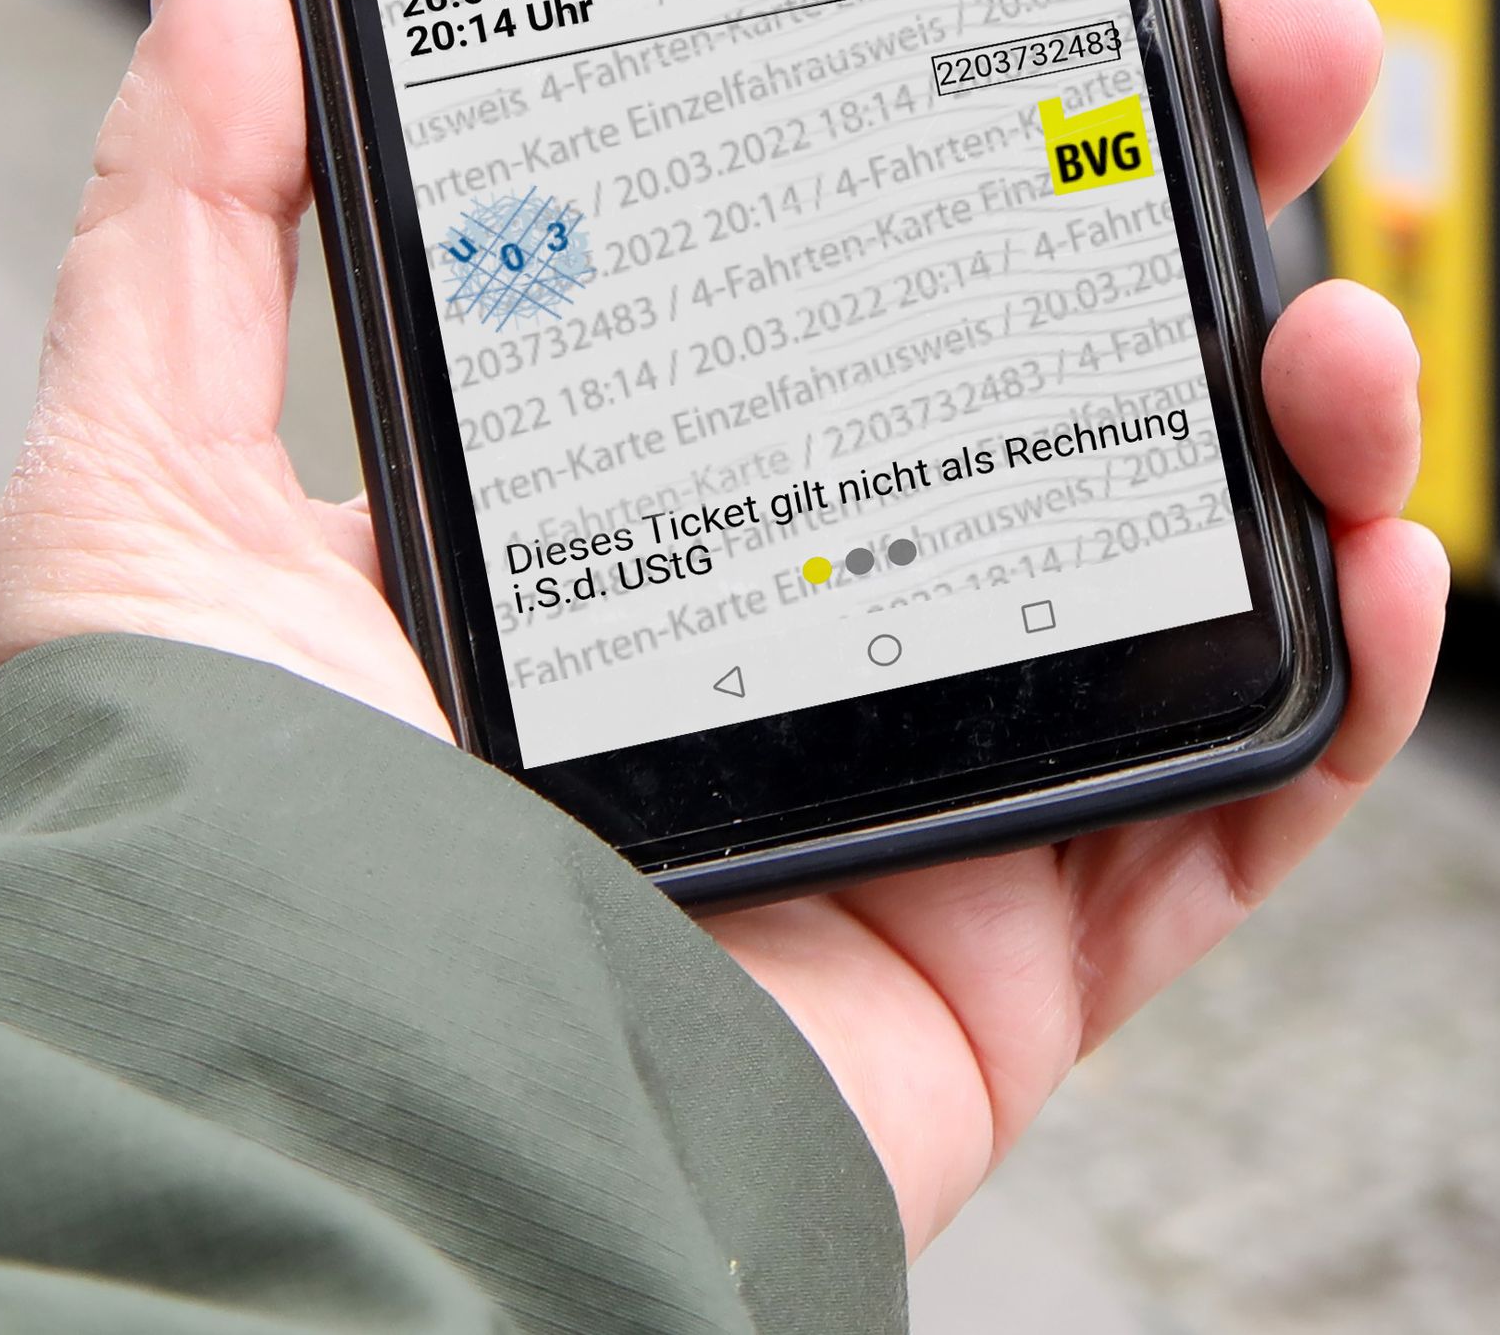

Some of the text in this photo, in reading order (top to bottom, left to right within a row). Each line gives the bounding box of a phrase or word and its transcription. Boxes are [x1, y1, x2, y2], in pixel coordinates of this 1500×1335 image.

[406, 7, 517, 58] 20:14
[628, 14, 943, 139] Einzelfahrausweis
[936, 26, 1123, 88] 2203732483
[615, 117, 808, 208] 20.03.2022
[1055, 131, 1142, 184] BVG
[448, 295, 657, 391] 203732483
[688, 198, 971, 311] 4-Fahrten-Karte
[560, 358, 657, 419] 18:14
[690, 283, 885, 376] 20.03.2022
[673, 316, 990, 445] Einzelfahrausweis
[506, 408, 1190, 575] Dieses Ticket gilt nicht als Rechnung
[515, 544, 713, 614] i.S.d. UStG
